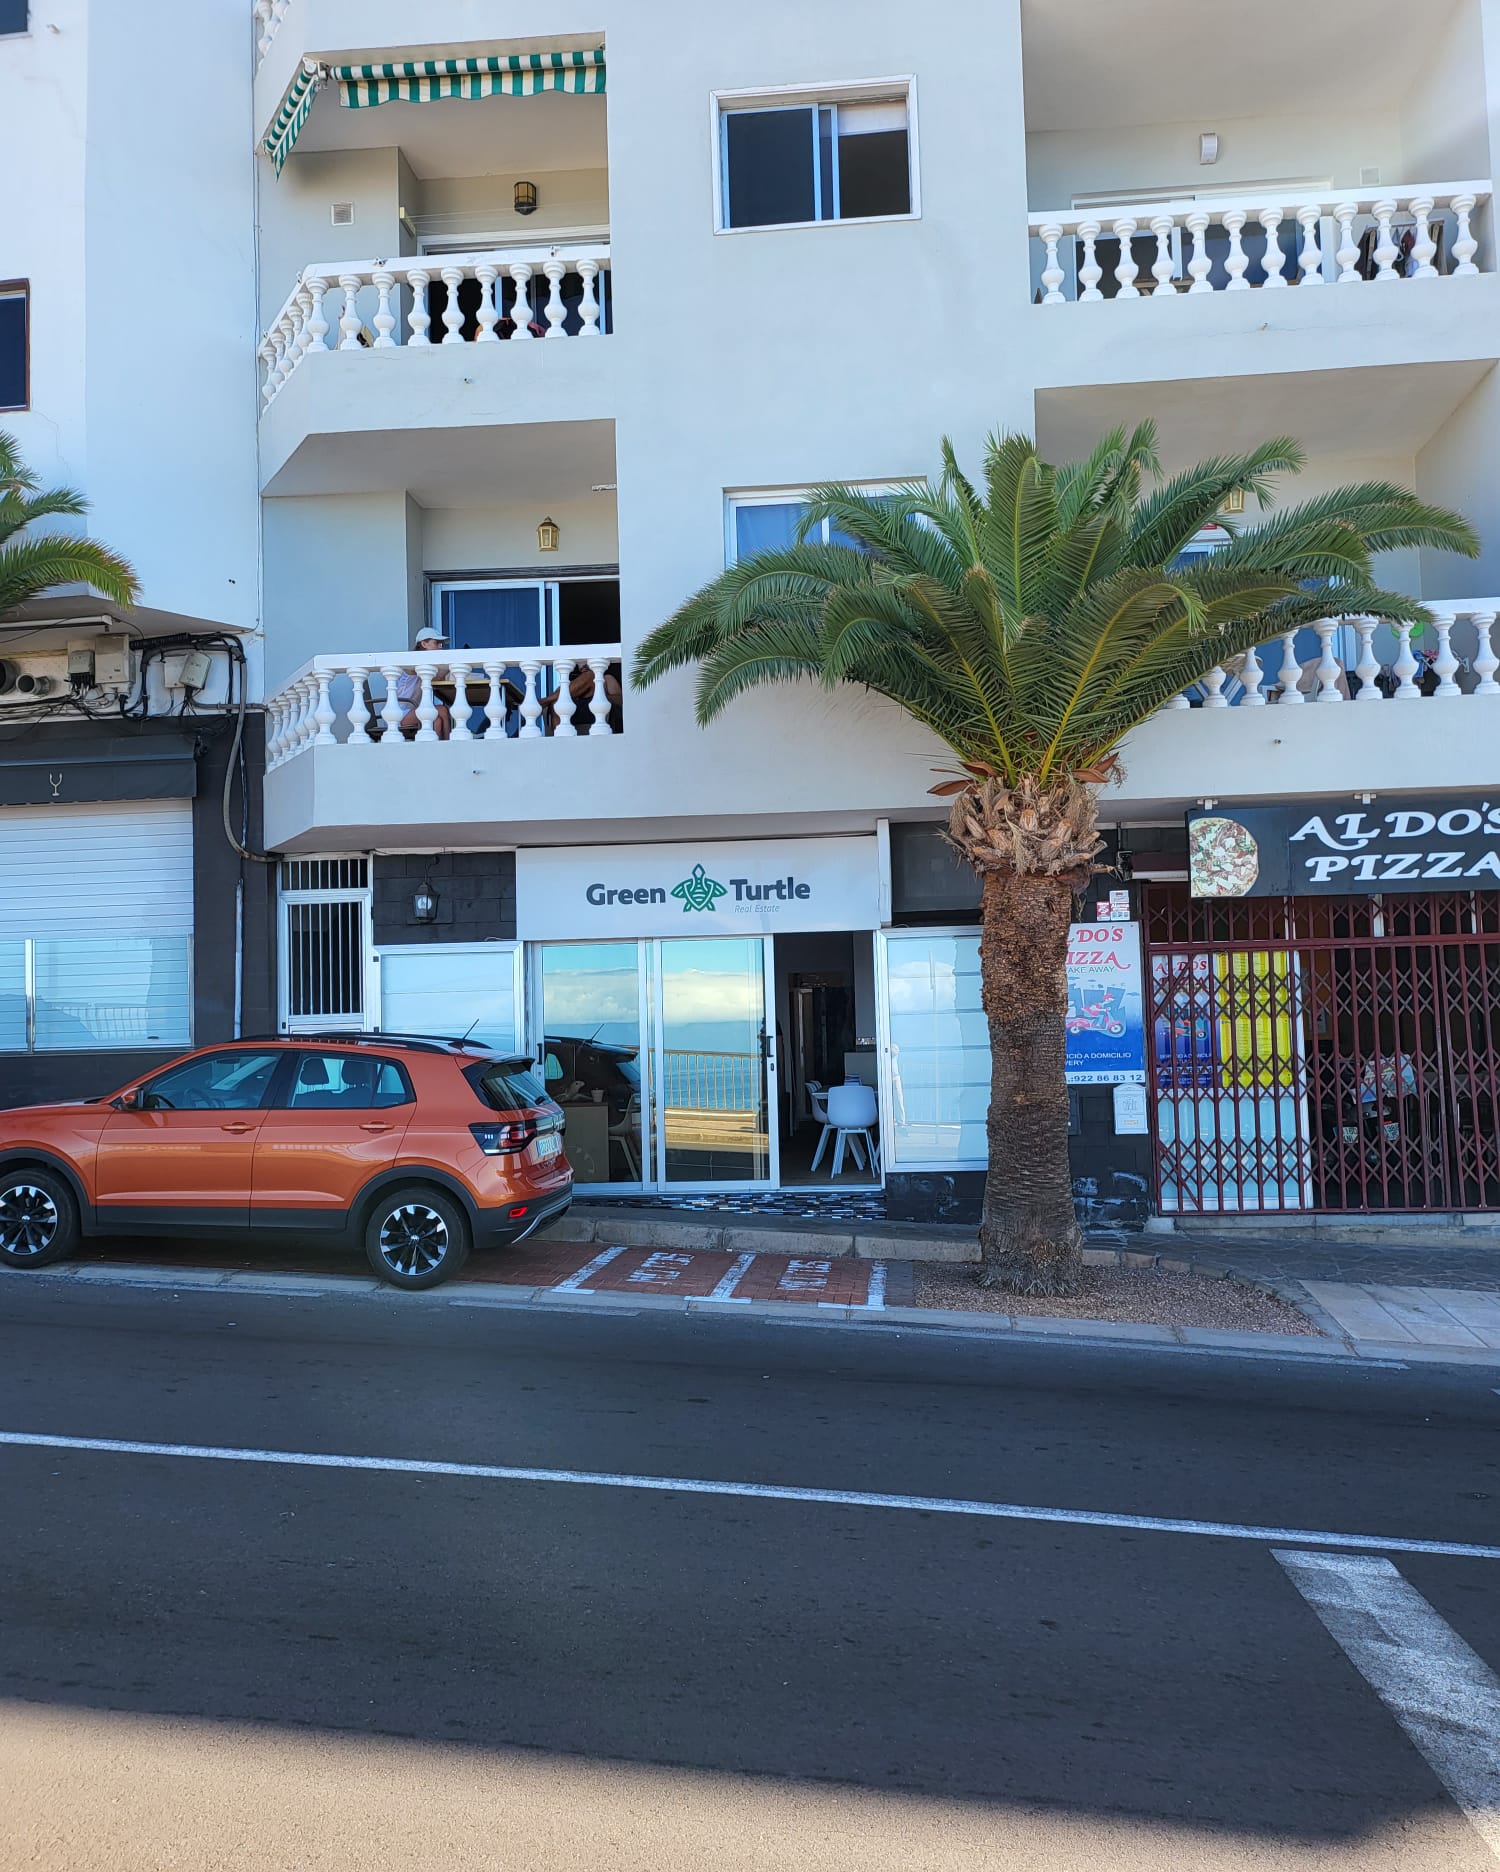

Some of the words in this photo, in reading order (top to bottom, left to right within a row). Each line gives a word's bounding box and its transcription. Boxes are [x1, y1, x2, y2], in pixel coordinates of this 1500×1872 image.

[1289, 802, 1500, 851] ALDO'S
[1305, 851, 1500, 882] PIZZA
[586, 883, 666, 906] Green
[729, 876, 811, 901] Turtle
[734, 905, 752, 913] Real
[754, 904, 780, 913] Estate
[1066, 951, 1132, 970] IZZA
[1112, 1074, 1126, 1082] 83
